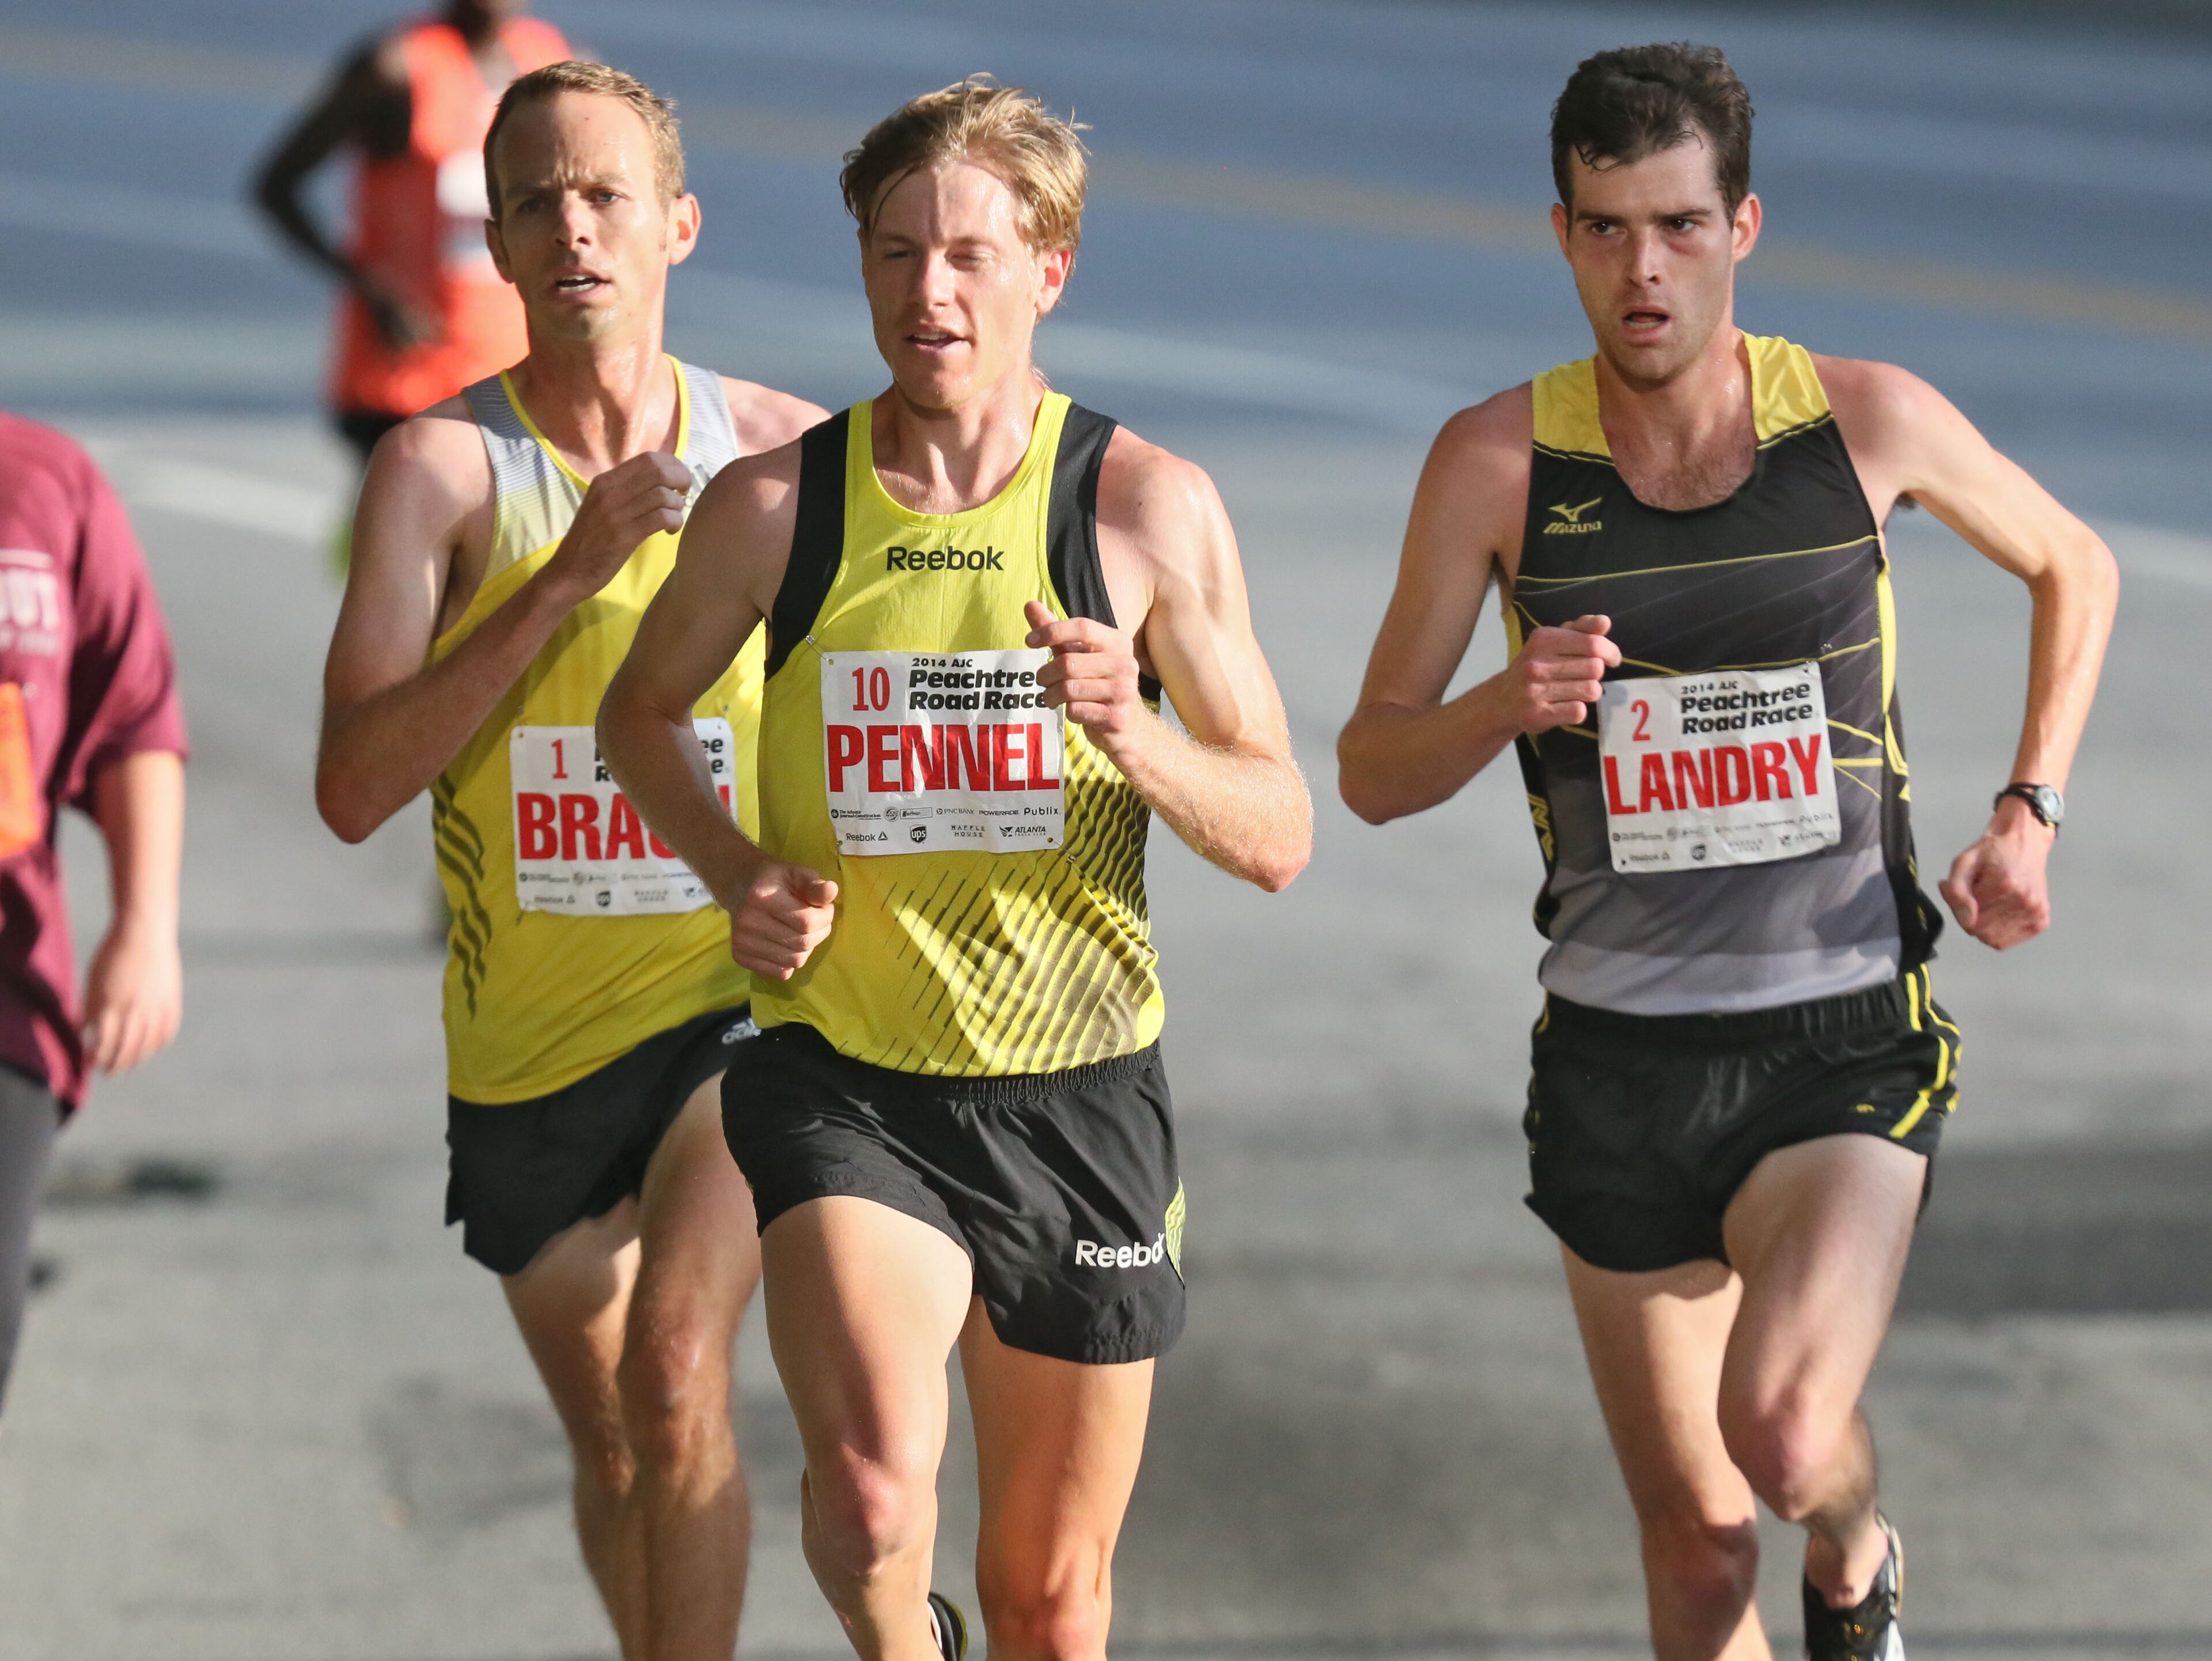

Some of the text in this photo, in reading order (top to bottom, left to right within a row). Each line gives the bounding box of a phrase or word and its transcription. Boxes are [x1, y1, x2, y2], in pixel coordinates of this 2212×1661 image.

[887, 546, 1005, 571] Reebok
[911, 657, 973, 668] 2014 AJC
[851, 666, 891, 712] 10
[909, 669, 1042, 689] Peachtre
[1681, 681, 1738, 694] 2014 AJC
[909, 691, 980, 710] Road
[1680, 682, 1810, 714] Peachtree
[1630, 698, 1651, 743] 2
[1682, 703, 1813, 735] Road Race
[551, 738, 568, 780] 1
[827, 723, 1060, 793] PENNEL
[1603, 733, 1822, 816] LANDRY
[516, 784, 731, 861] BRA
[1024, 807, 1059, 816] Publix
[846, 833, 876, 842] Reebok
[911, 830, 926, 841] ups
